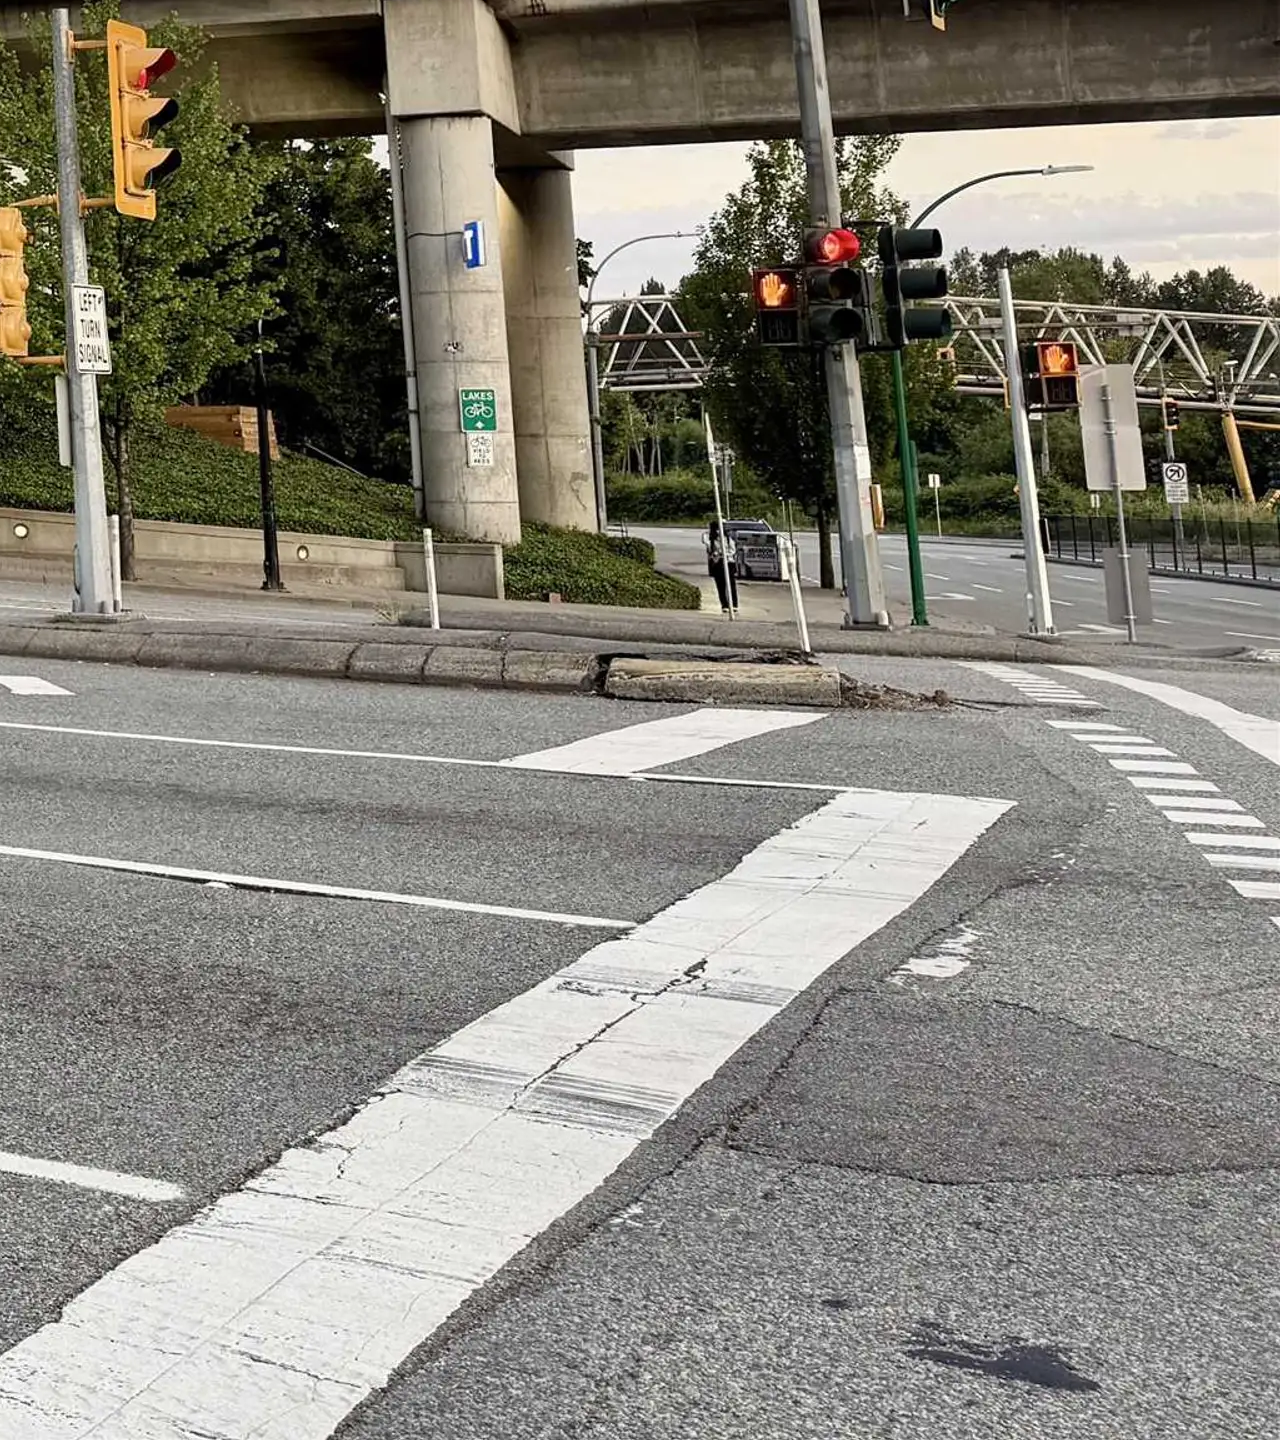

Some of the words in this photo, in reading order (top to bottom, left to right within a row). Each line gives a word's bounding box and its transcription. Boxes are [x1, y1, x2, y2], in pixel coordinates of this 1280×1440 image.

[79, 292, 97, 312] LEFT
[80, 318, 101, 339] TURN
[79, 343, 108, 364] SIGNAL
[462, 391, 493, 401] LAKES
